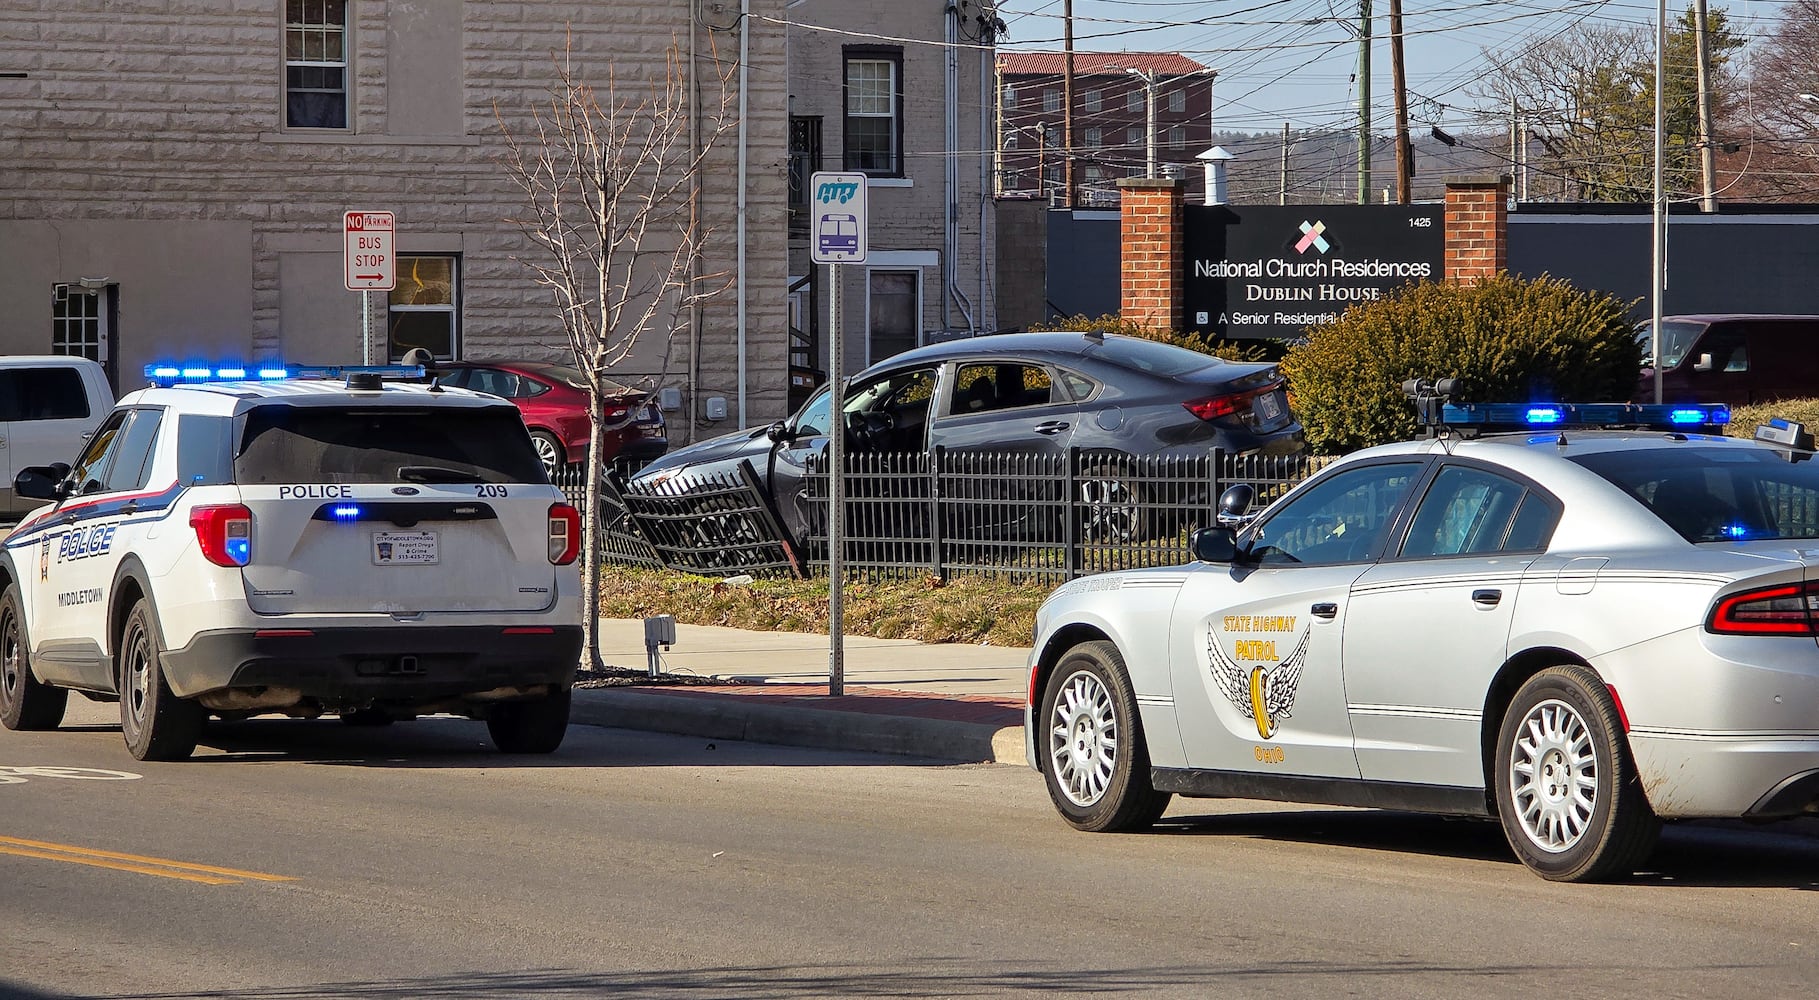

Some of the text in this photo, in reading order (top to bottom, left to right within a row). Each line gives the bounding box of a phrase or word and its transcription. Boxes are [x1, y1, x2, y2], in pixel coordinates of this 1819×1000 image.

[347, 215, 391, 229] NO PARKING
[1408, 217, 1432, 228] 1425
[358, 237, 381, 249] BUS
[355, 254, 385, 267] STOP
[1194, 258, 1431, 278] National Church Residences
[1246, 284, 1380, 301] DUBLIN HOUSE
[1218, 312, 1228, 325] A
[1232, 312, 1269, 325] Senior
[1274, 312, 1337, 325] Residential
[279, 485, 353, 499] POLICE
[474, 484, 508, 499] 209
[57, 521, 121, 564] POLICE
[58, 588, 103, 607] MIDDLETOWN
[1223, 615, 1297, 633] STATE HIGHWAY
[1235, 639, 1280, 662] PATROL
[1254, 745, 1285, 764] OHIO
